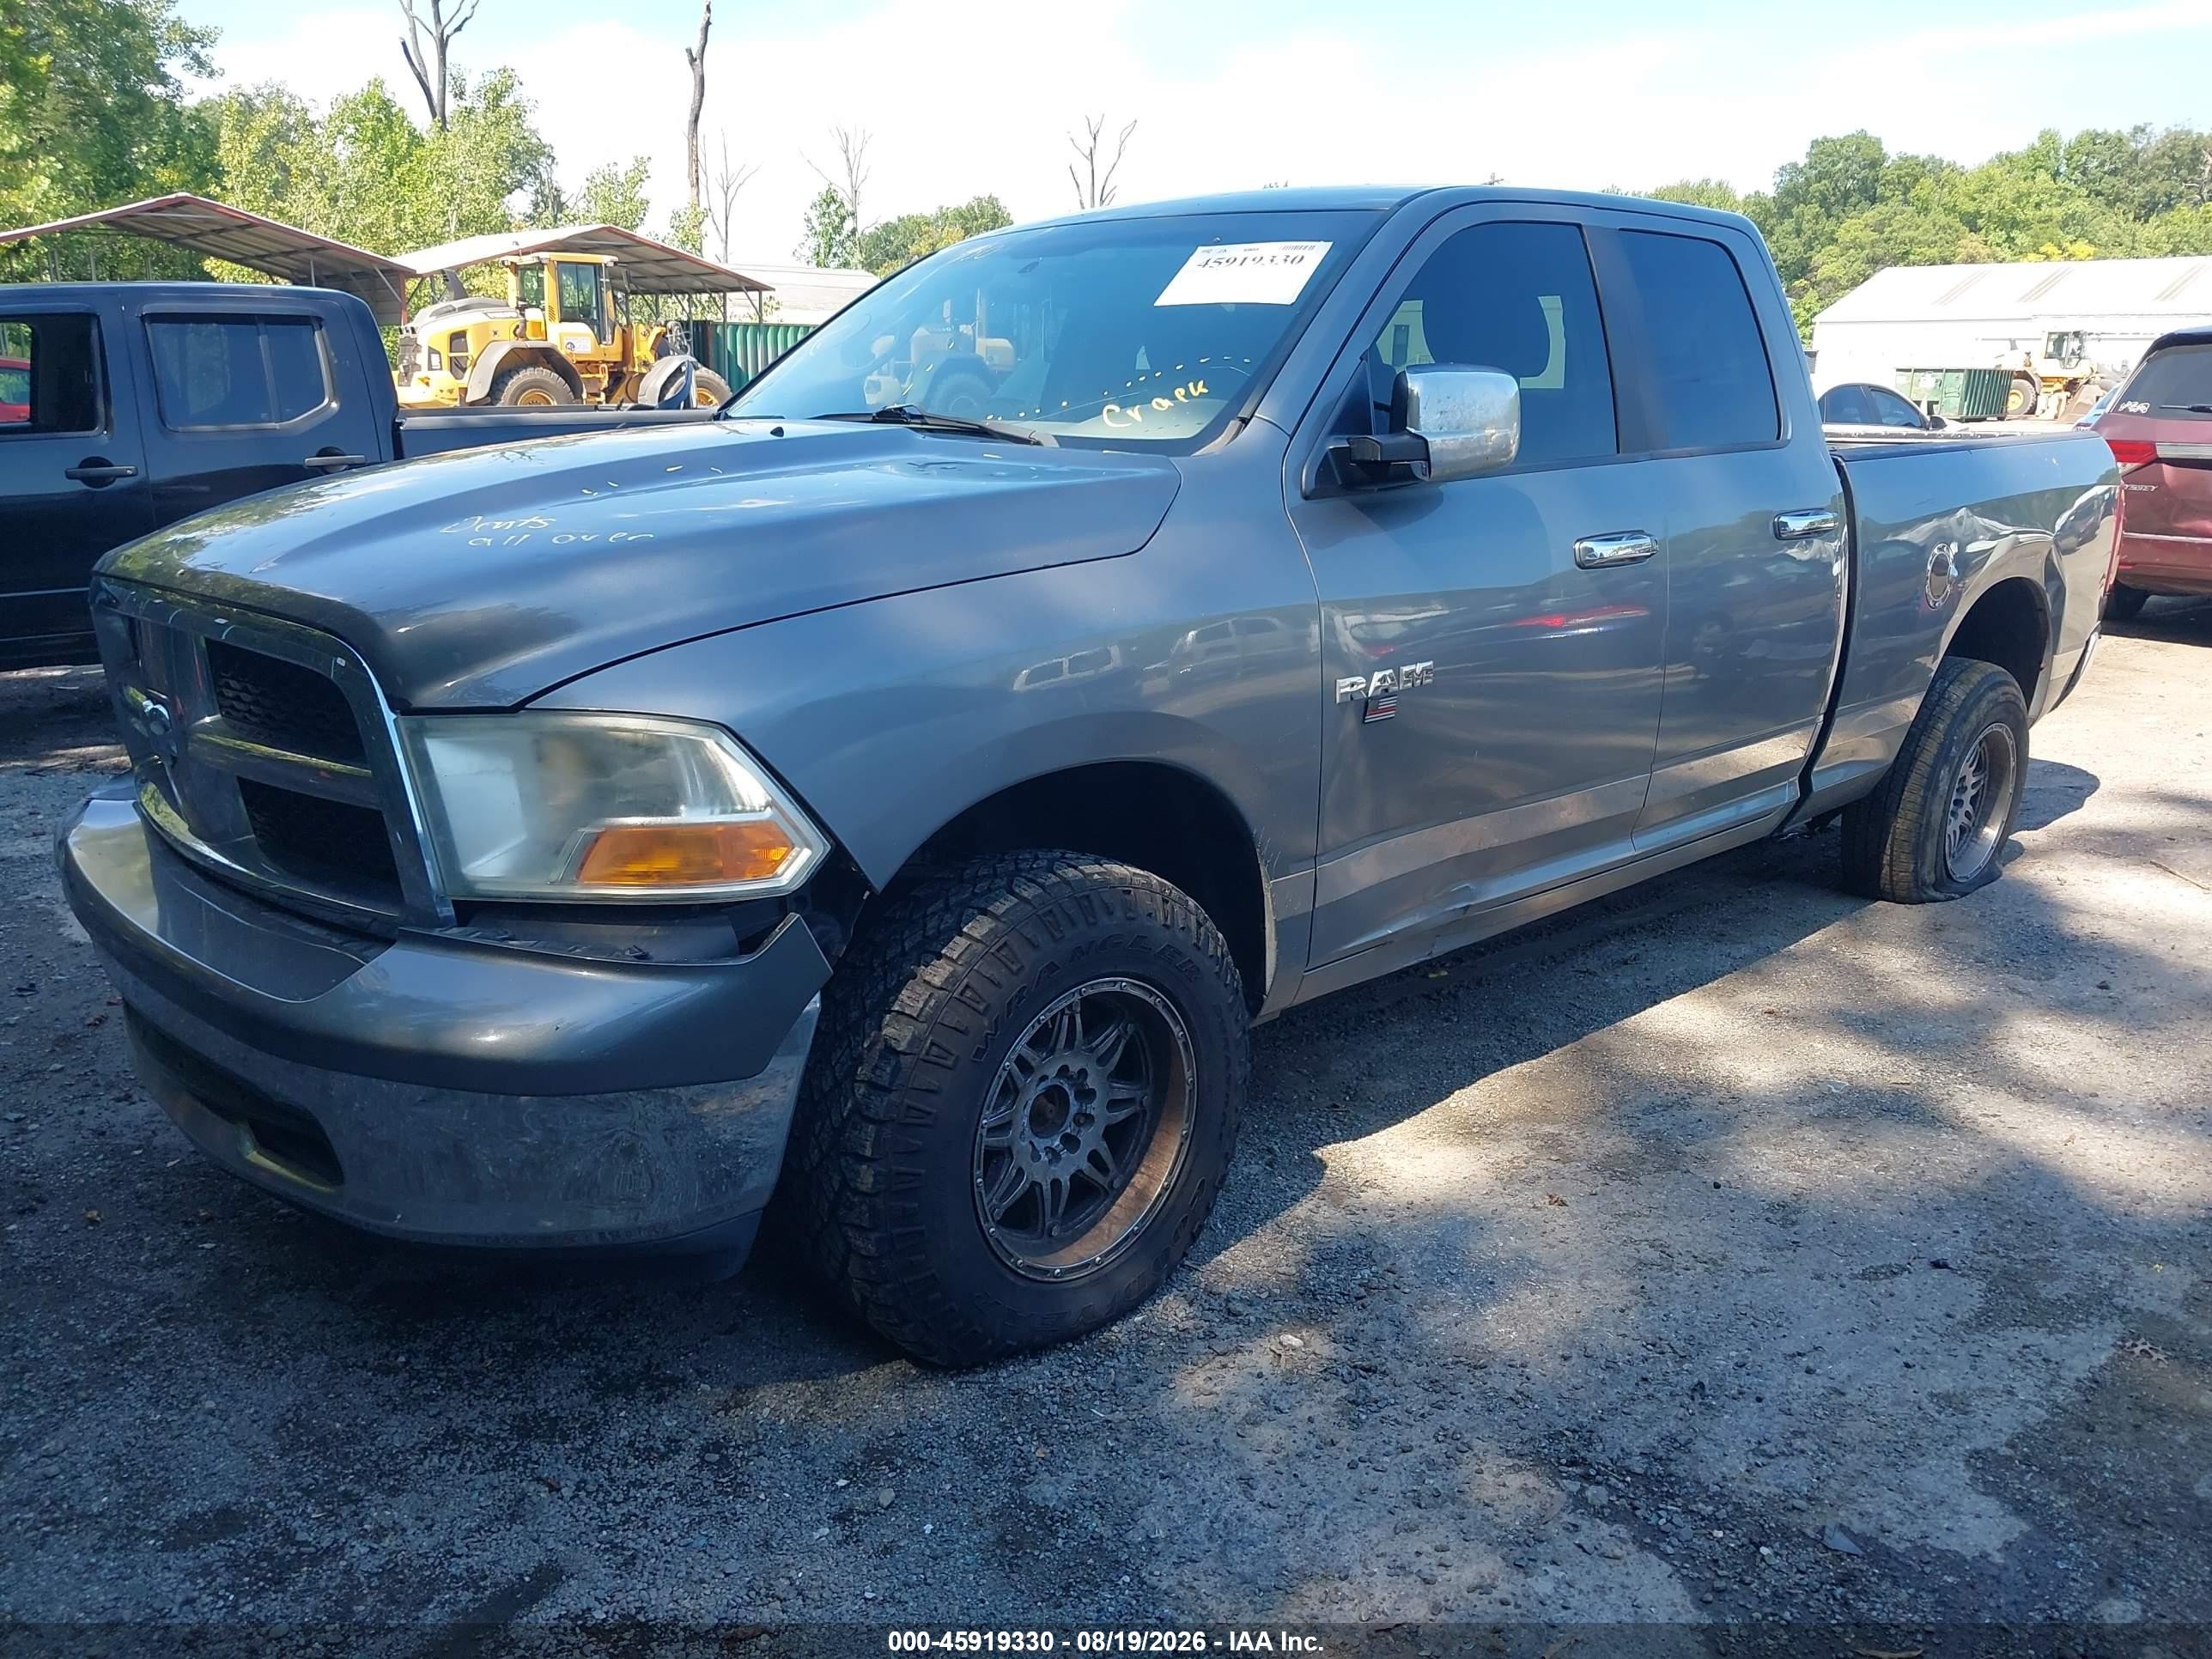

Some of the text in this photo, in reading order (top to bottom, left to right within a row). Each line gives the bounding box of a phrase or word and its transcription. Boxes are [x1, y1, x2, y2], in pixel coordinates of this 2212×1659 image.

[1196, 254, 1306, 269] 45919330
[467, 531, 655, 547] all over
[969, 933, 1203, 1063] WRANGLER
